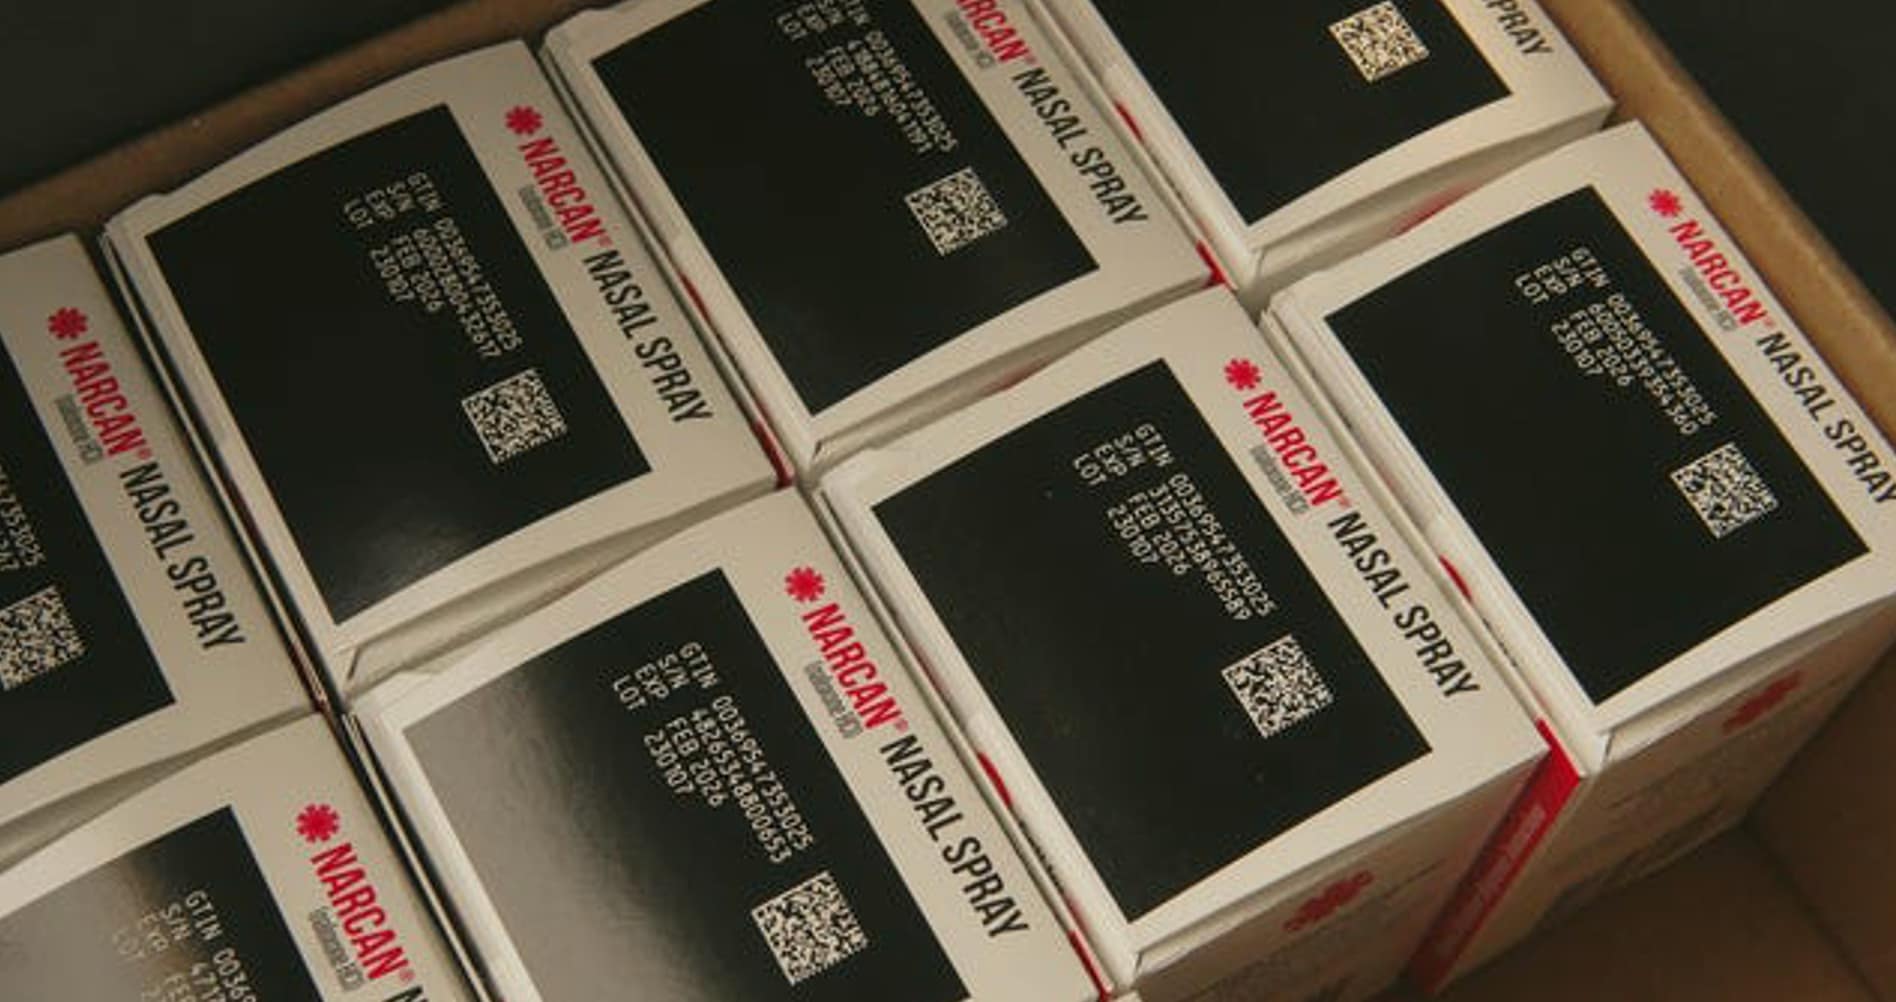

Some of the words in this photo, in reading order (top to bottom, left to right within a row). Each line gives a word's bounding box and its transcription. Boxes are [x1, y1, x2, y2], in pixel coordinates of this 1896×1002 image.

[777, 12, 808, 41] LOT
[820, 46, 855, 77] FEB
[1482, 0, 1553, 53] PRAY
[387, 182, 414, 212] S/N
[1012, 65, 1087, 149] NASAL
[1070, 147, 1148, 224] SPRAY
[344, 199, 374, 229] LOT
[370, 245, 415, 301] 230107
[365, 190, 395, 219] EXP
[391, 235, 421, 268] FEB
[410, 271, 445, 312] 2026
[408, 172, 442, 212] GTIN
[434, 218, 522, 350] 00369547353025
[1552, 256, 1584, 287] S/N
[583, 250, 657, 339] NASAL
[635, 337, 712, 422] SPRAY
[1515, 274, 1549, 304] LOT
[1552, 320, 1603, 374] 230107
[1534, 265, 1567, 294] EXP
[1570, 310, 1602, 343] FEB
[1591, 346, 1634, 386] 2026
[1571, 248, 1610, 287] GTIN
[1607, 293, 1717, 427] 00369547353025
[1114, 434, 1146, 467] S/N
[1757, 332, 1835, 421] NASAL
[1824, 419, 1896, 503] SPRAY
[120, 462, 194, 560] NASAL
[166, 556, 245, 649] SPRAY
[1073, 453, 1107, 485] LOT
[1107, 504, 1160, 563] 230107
[1094, 443, 1127, 476] EXP
[1128, 493, 1160, 529] FEB
[1152, 530, 1192, 575] 2026
[1135, 424, 1174, 467] GTIN
[1168, 474, 1276, 616] 00369547353025
[1328, 512, 1410, 609] NASAL
[1394, 605, 1480, 697] SPRAY
[657, 654, 689, 689] S/N
[613, 675, 646, 710] LOT
[644, 730, 695, 793] 230107
[635, 663, 669, 698] EXP
[666, 717, 699, 756] FEB
[689, 758, 728, 807] 2026
[680, 642, 718, 688] GTIN
[712, 696, 813, 850] 00369547353025
[880, 734, 963, 842] NASAL
[942, 837, 1029, 937] SPRAY
[158, 903, 191, 944] S/N
[185, 891, 222, 940] GTIN
